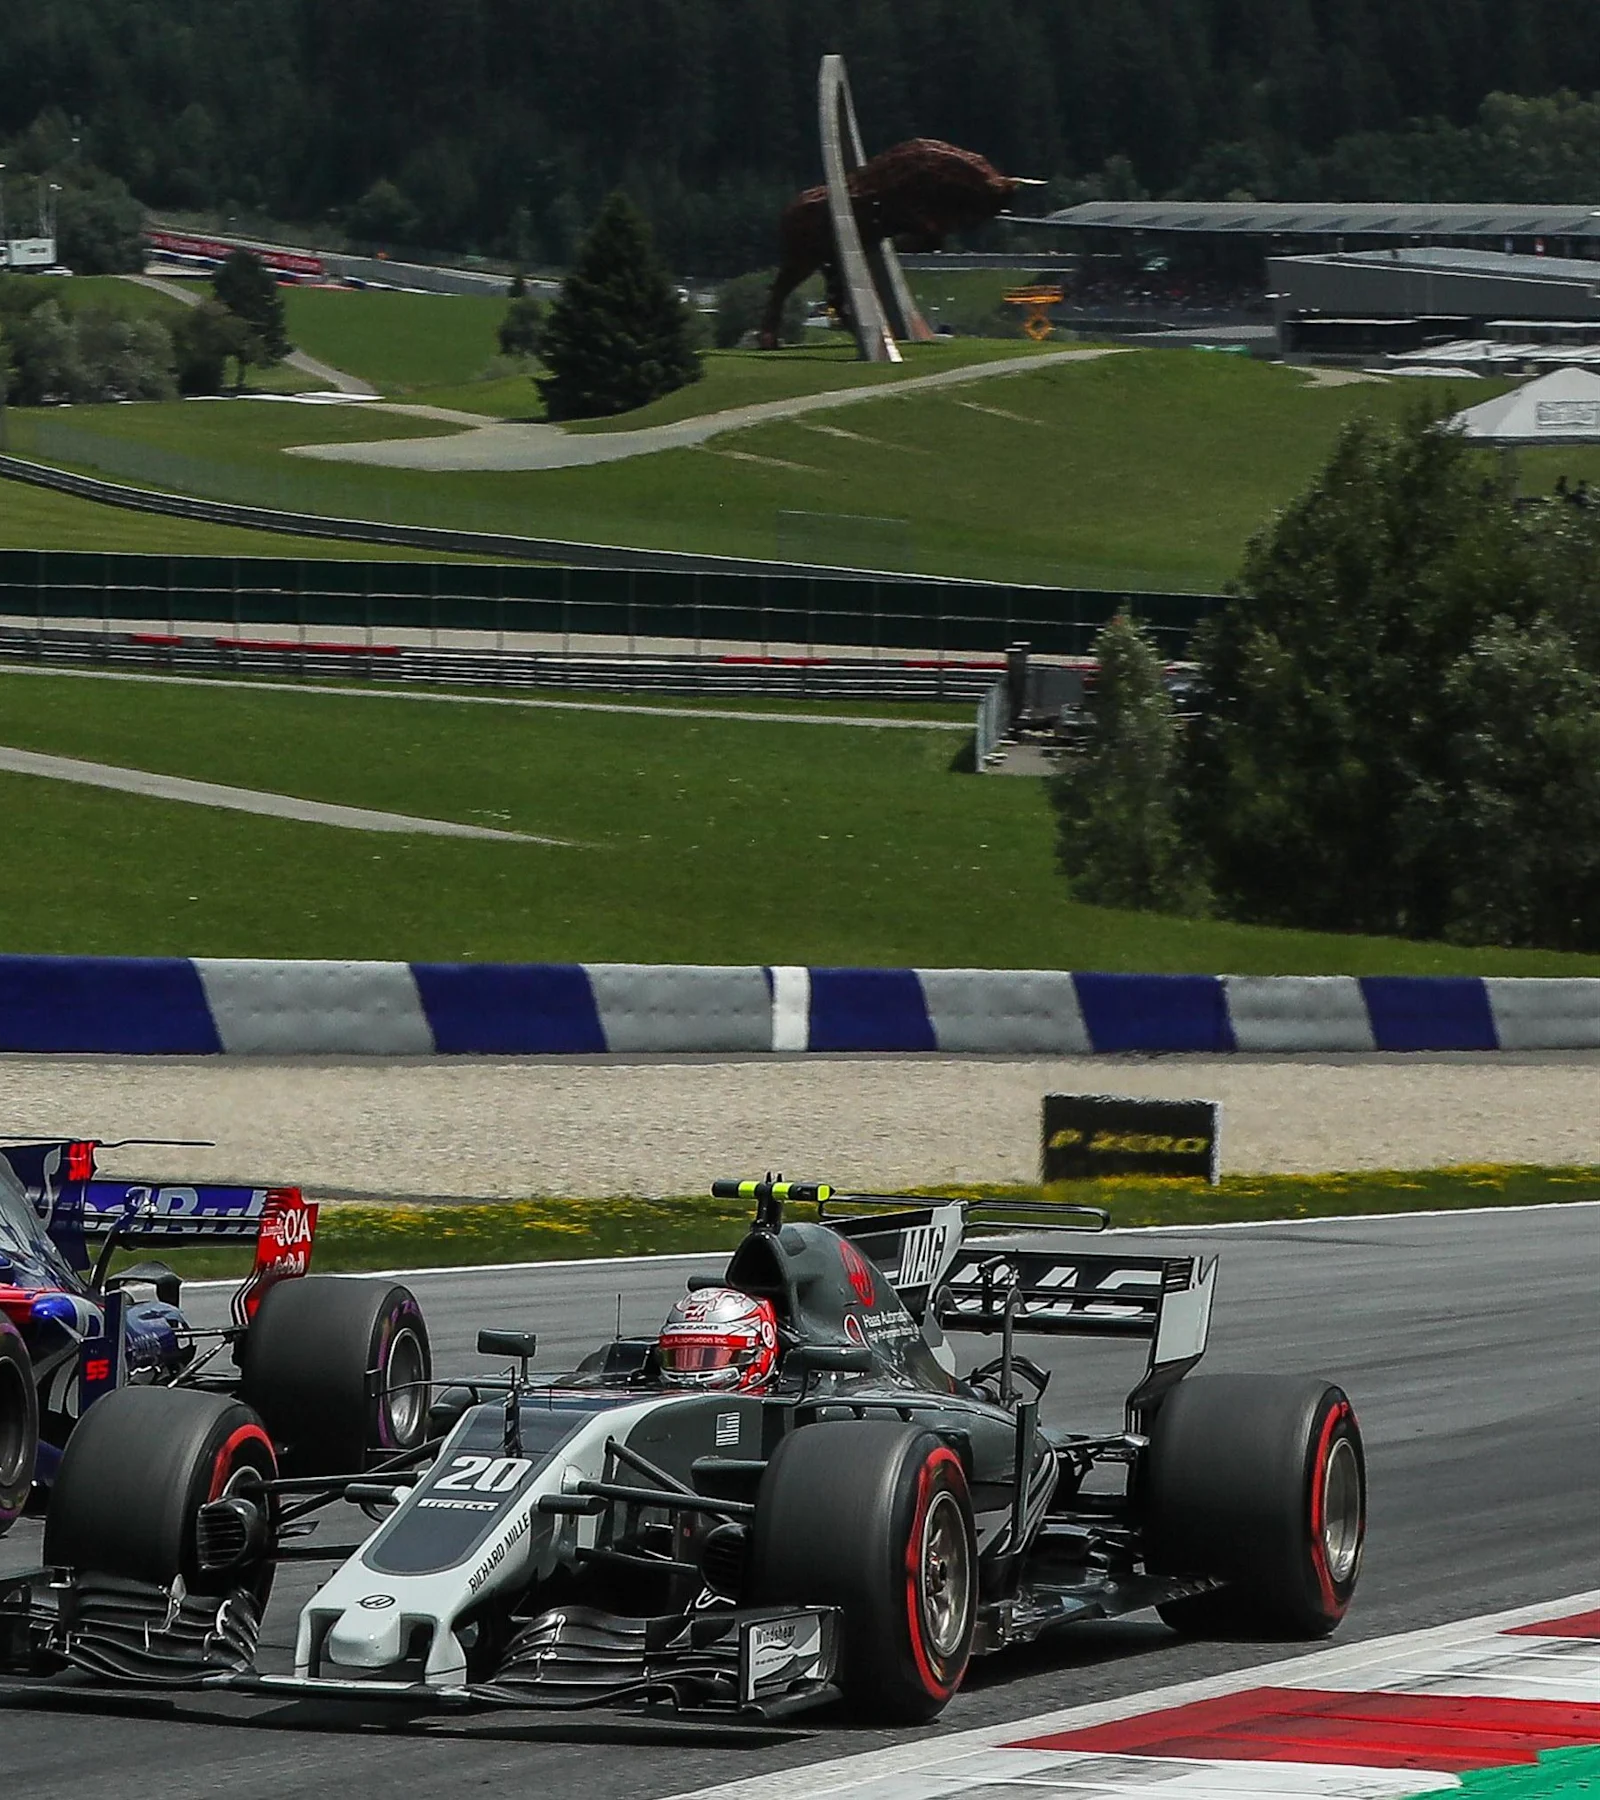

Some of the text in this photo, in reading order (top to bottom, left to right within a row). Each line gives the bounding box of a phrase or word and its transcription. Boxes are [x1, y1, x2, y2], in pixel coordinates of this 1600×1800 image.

[1049, 1129, 1209, 1153] P ZERO
[900, 1225, 944, 1286] MAG
[674, 1336, 713, 1345] Automation
[714, 1337, 728, 1345] Inc.
[86, 1359, 109, 1381] 55
[433, 1455, 533, 1493] 20
[417, 1498, 500, 1513] PIRELLI
[467, 1511, 530, 1595] RICHARD MILLE
[756, 1624, 796, 1645] Windshear
